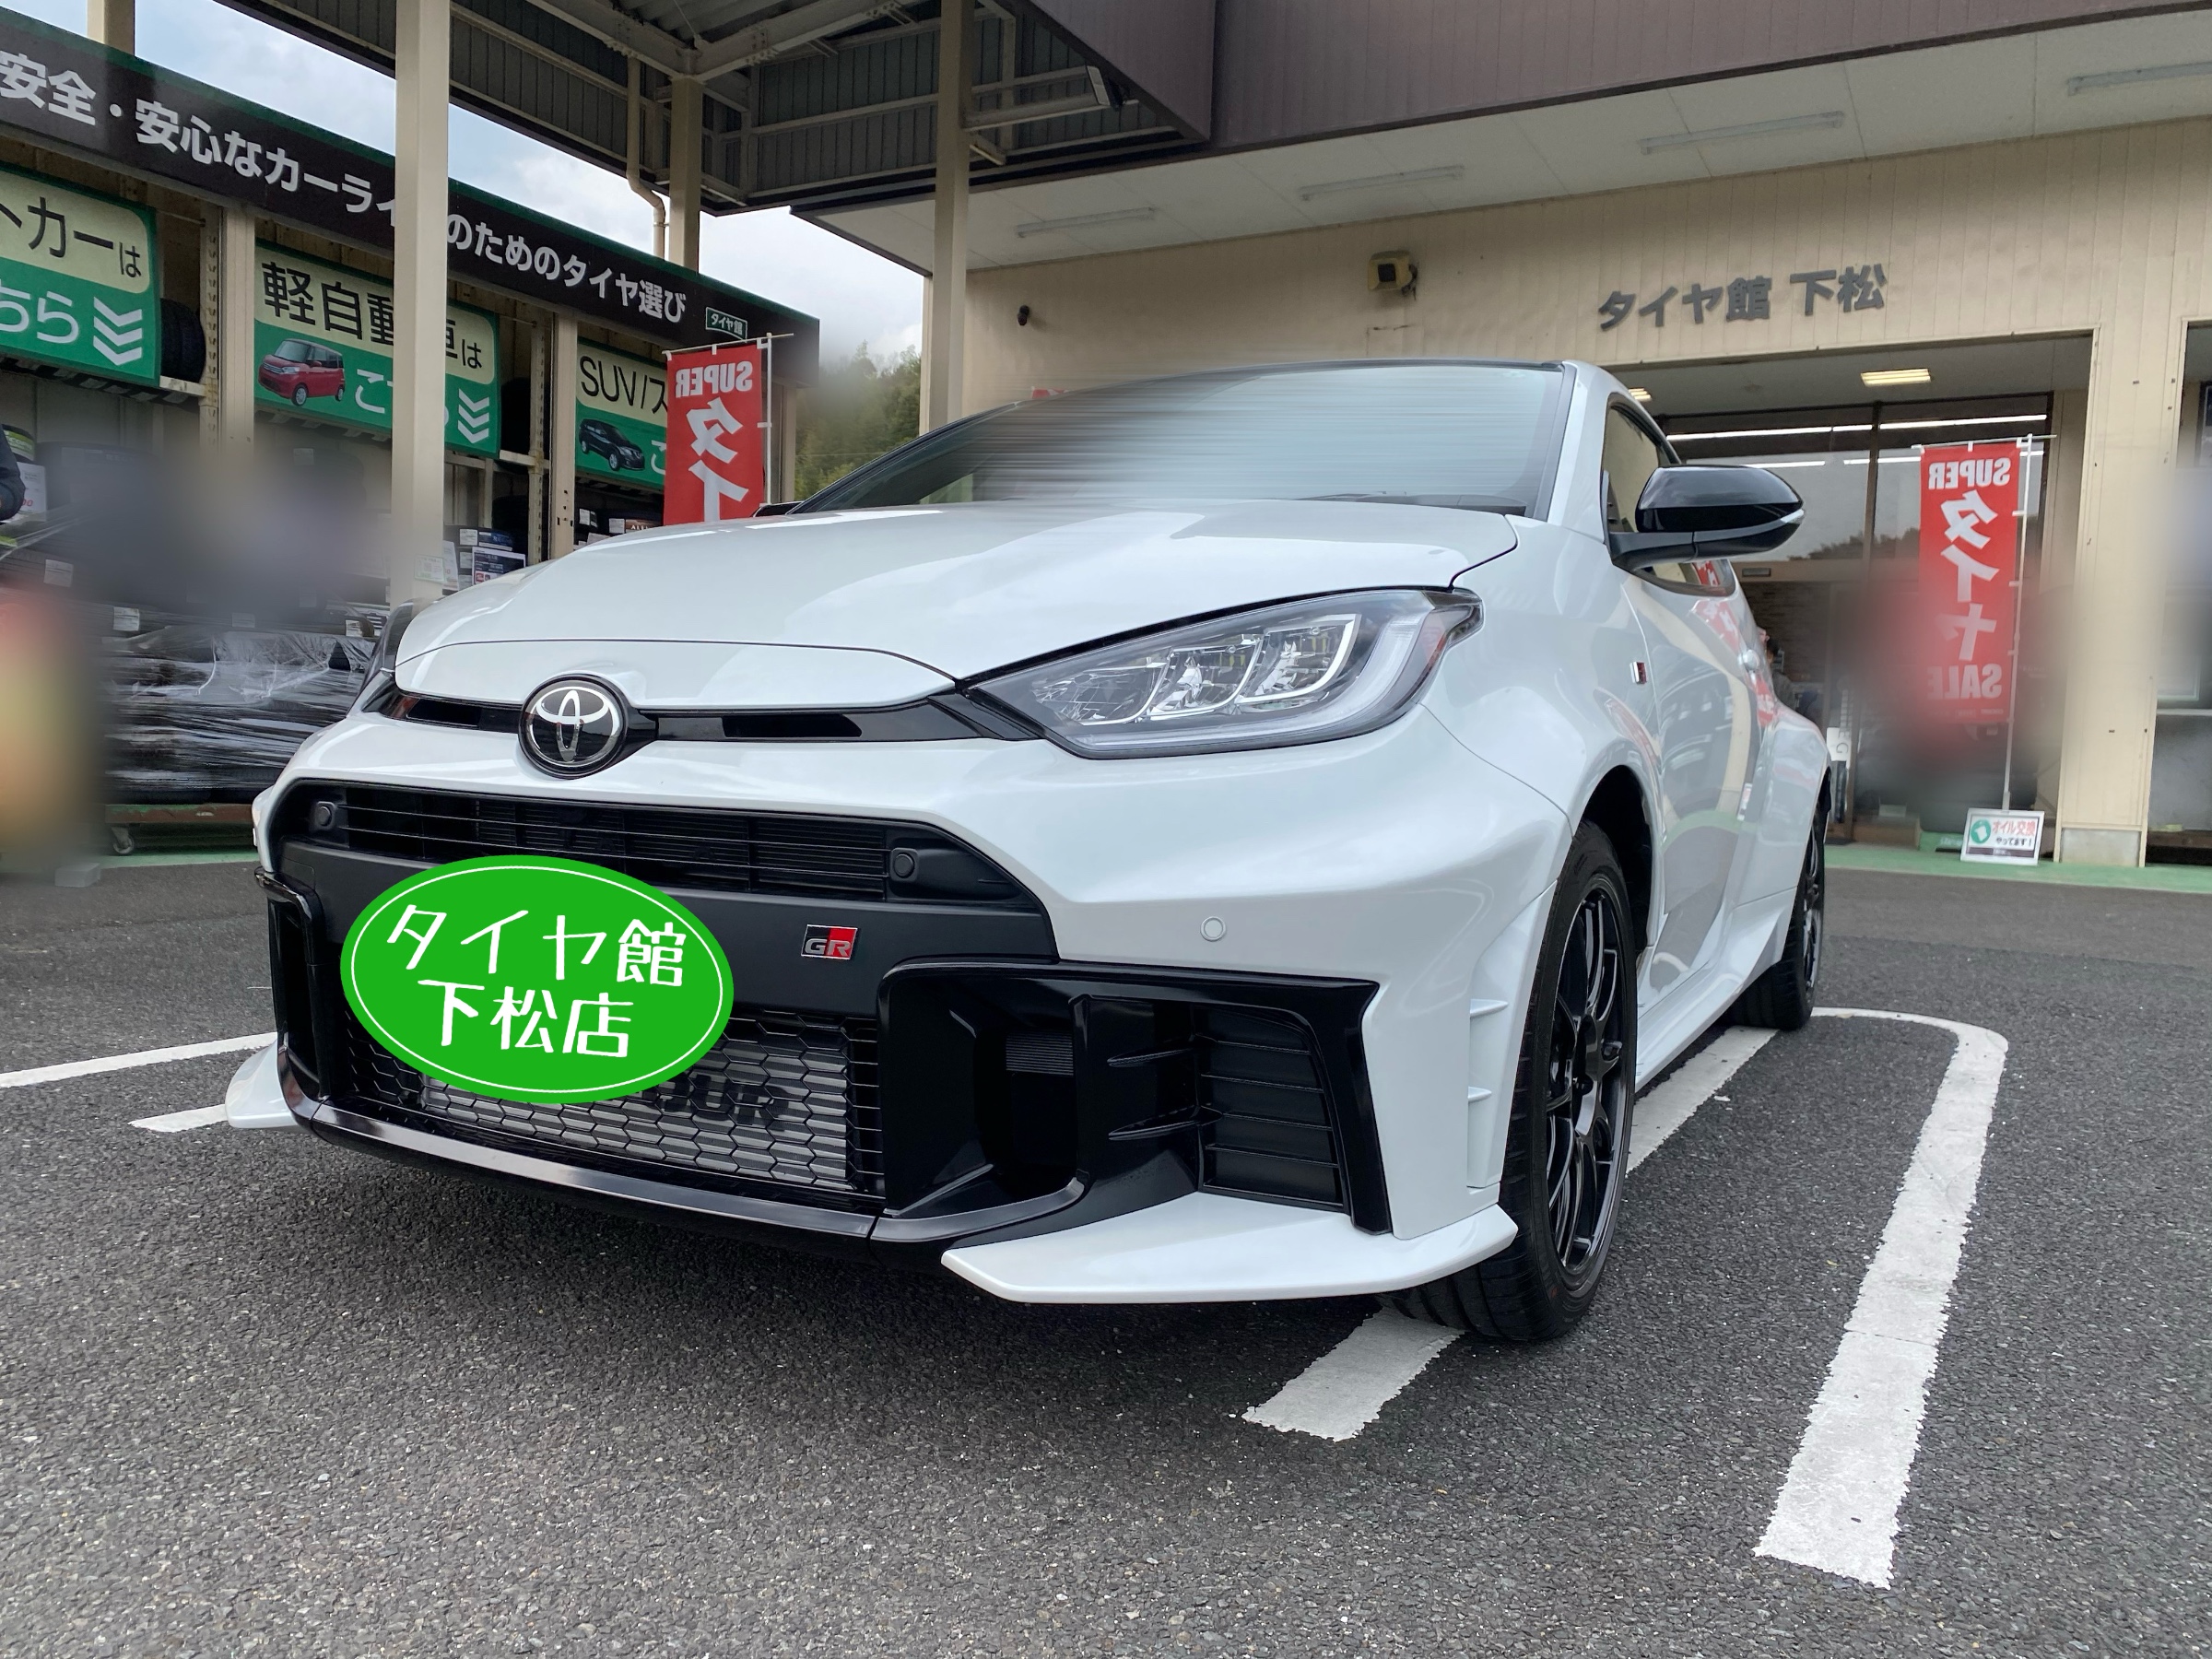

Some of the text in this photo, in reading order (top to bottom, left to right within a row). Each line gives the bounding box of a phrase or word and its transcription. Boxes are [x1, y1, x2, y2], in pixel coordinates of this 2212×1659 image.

[1598, 264, 1888, 331] タイヤ館 下松
[711, 312, 743, 335] タイヤ館
[805, 937, 852, 957] GR
